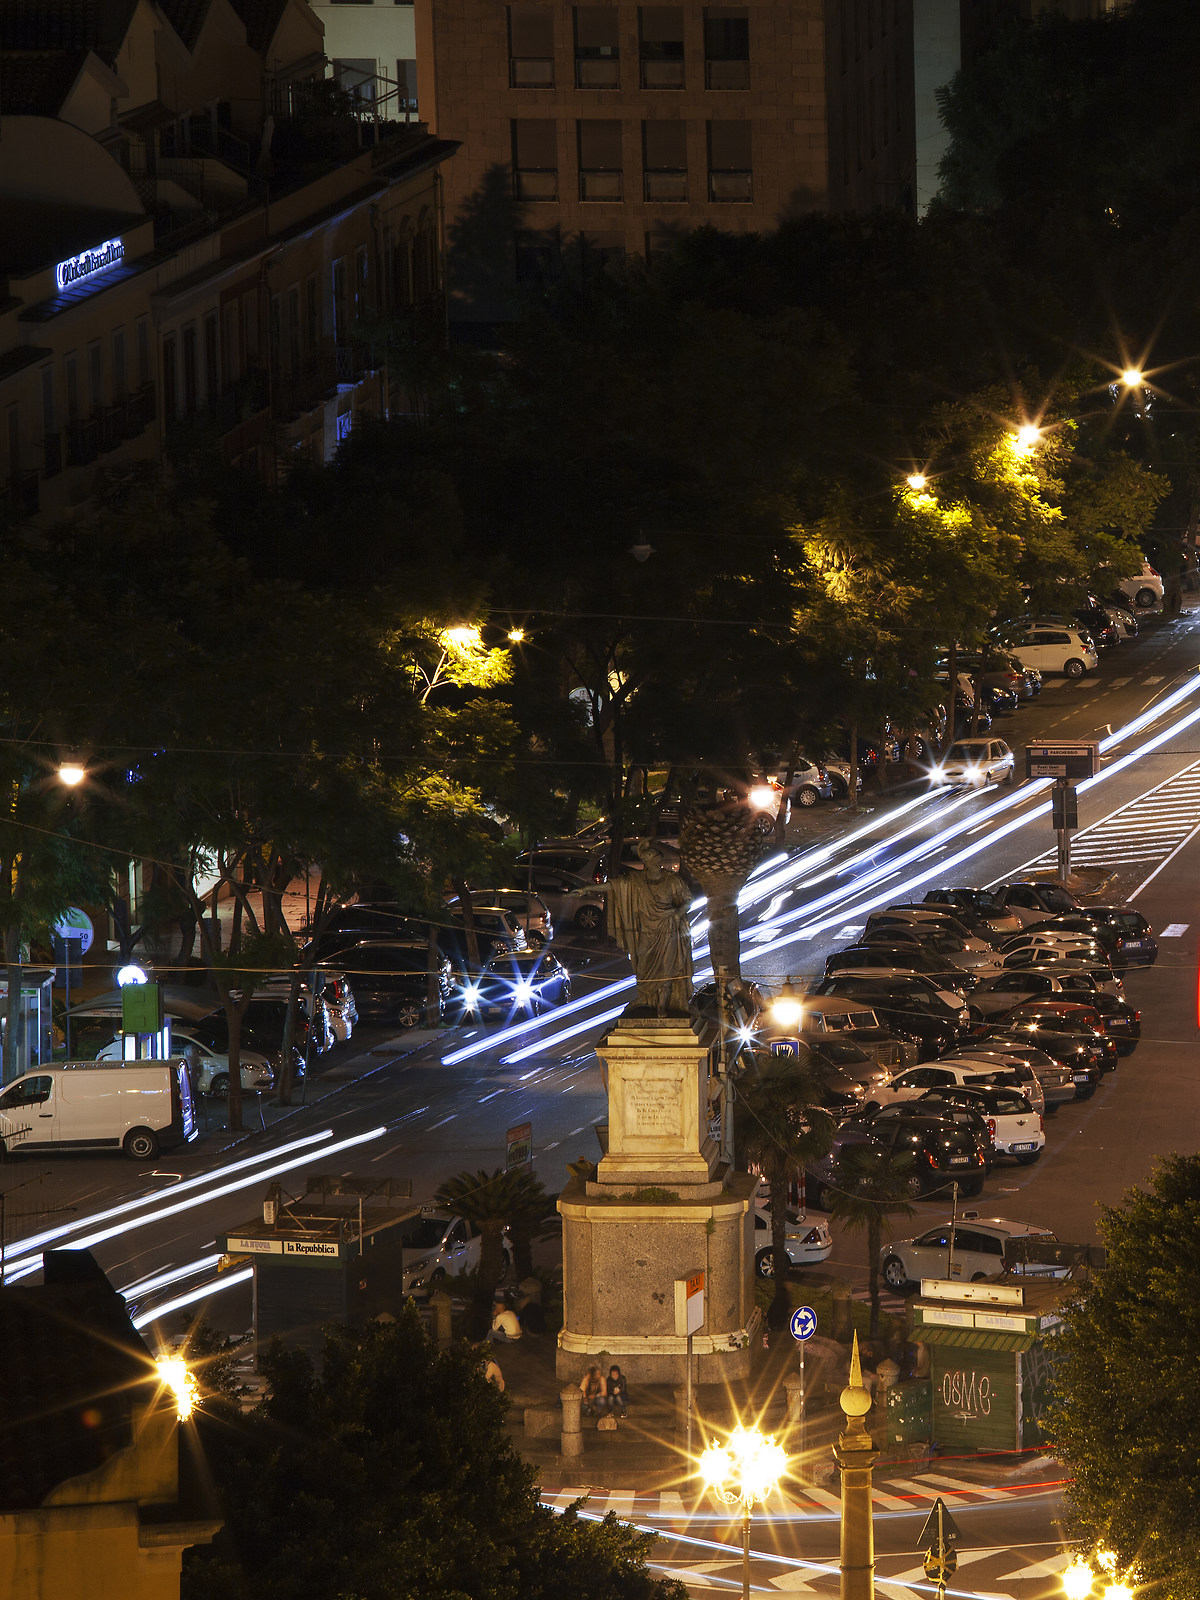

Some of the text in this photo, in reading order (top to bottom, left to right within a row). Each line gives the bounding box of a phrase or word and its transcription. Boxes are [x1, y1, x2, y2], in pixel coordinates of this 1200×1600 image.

[240, 1240, 271, 1249] LA NUOVA
[287, 1243, 335, 1254] la Repubblica
